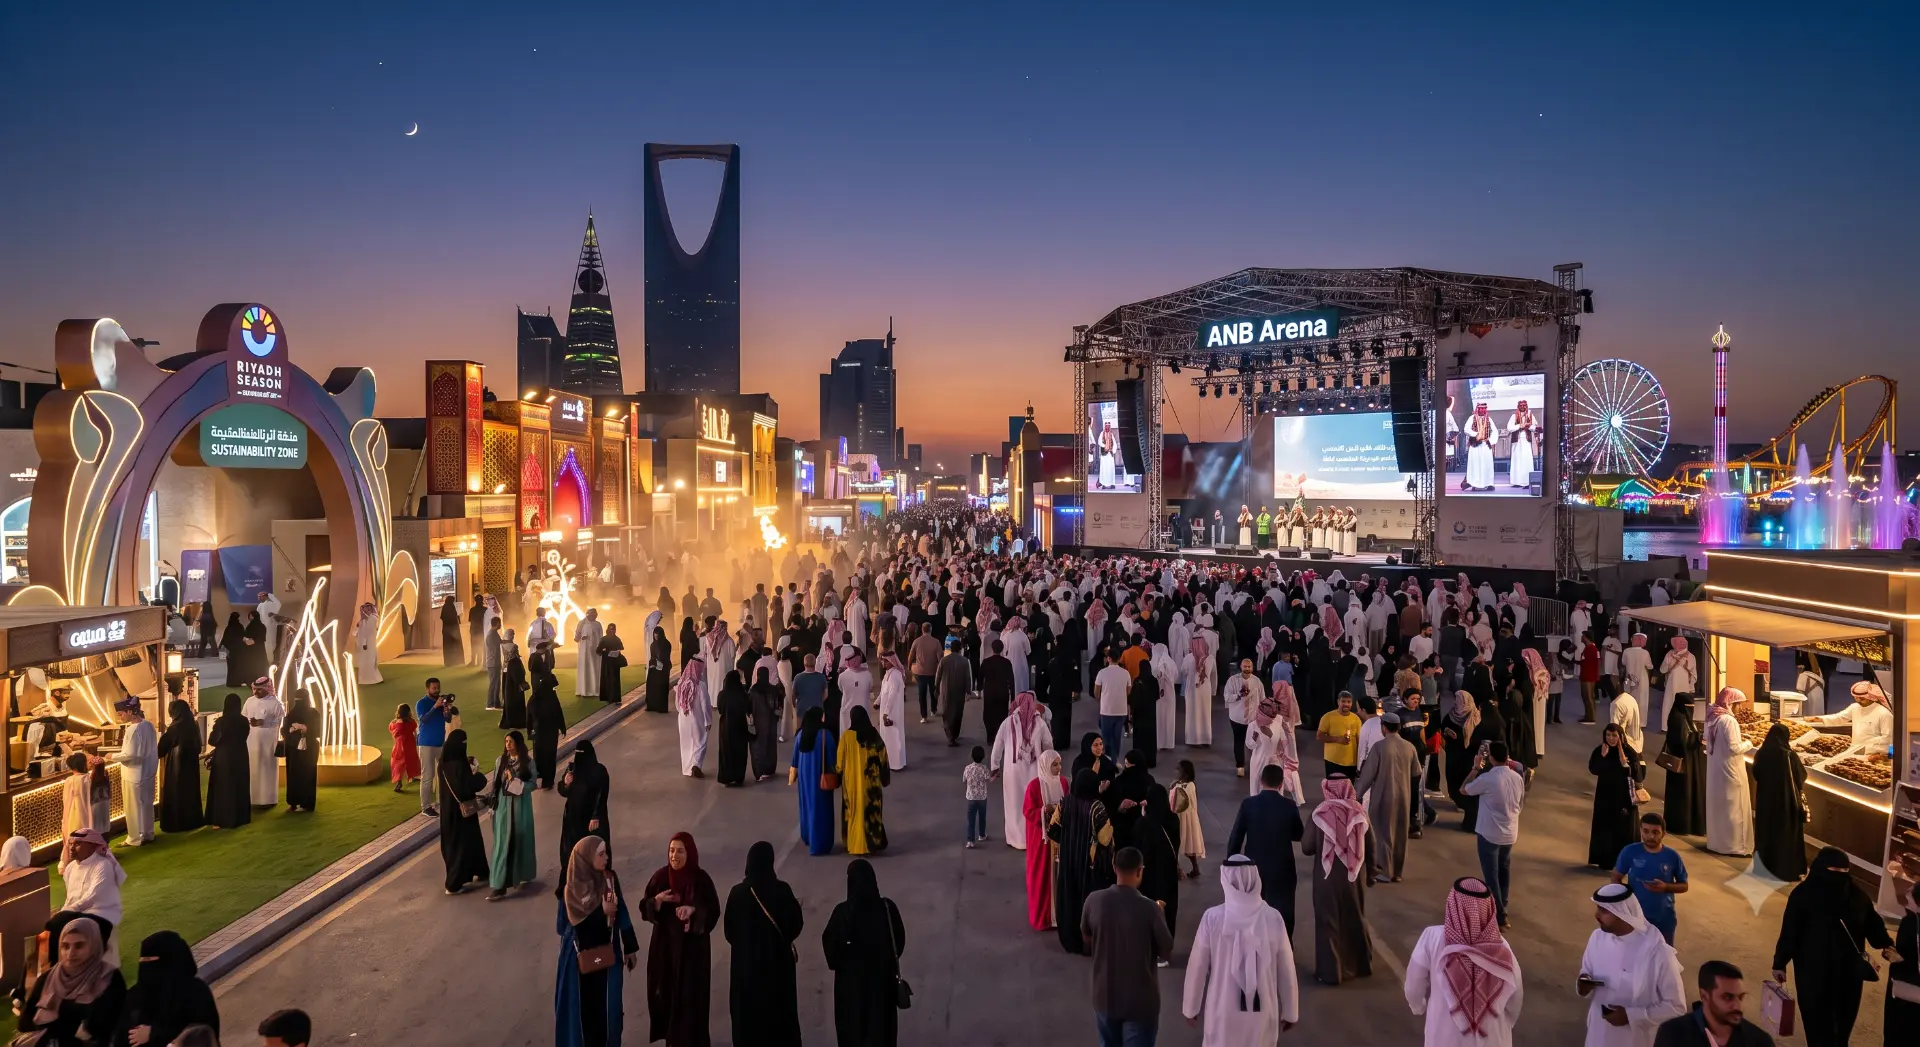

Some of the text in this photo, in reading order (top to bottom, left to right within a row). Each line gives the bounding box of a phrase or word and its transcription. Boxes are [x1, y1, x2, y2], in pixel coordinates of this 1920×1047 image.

[1206, 318, 1328, 348] ANB Arena
[236, 360, 282, 377] RIYADH
[237, 374, 282, 389] SEASON
[211, 443, 298, 458] SUSTAINABILITY ZONE
